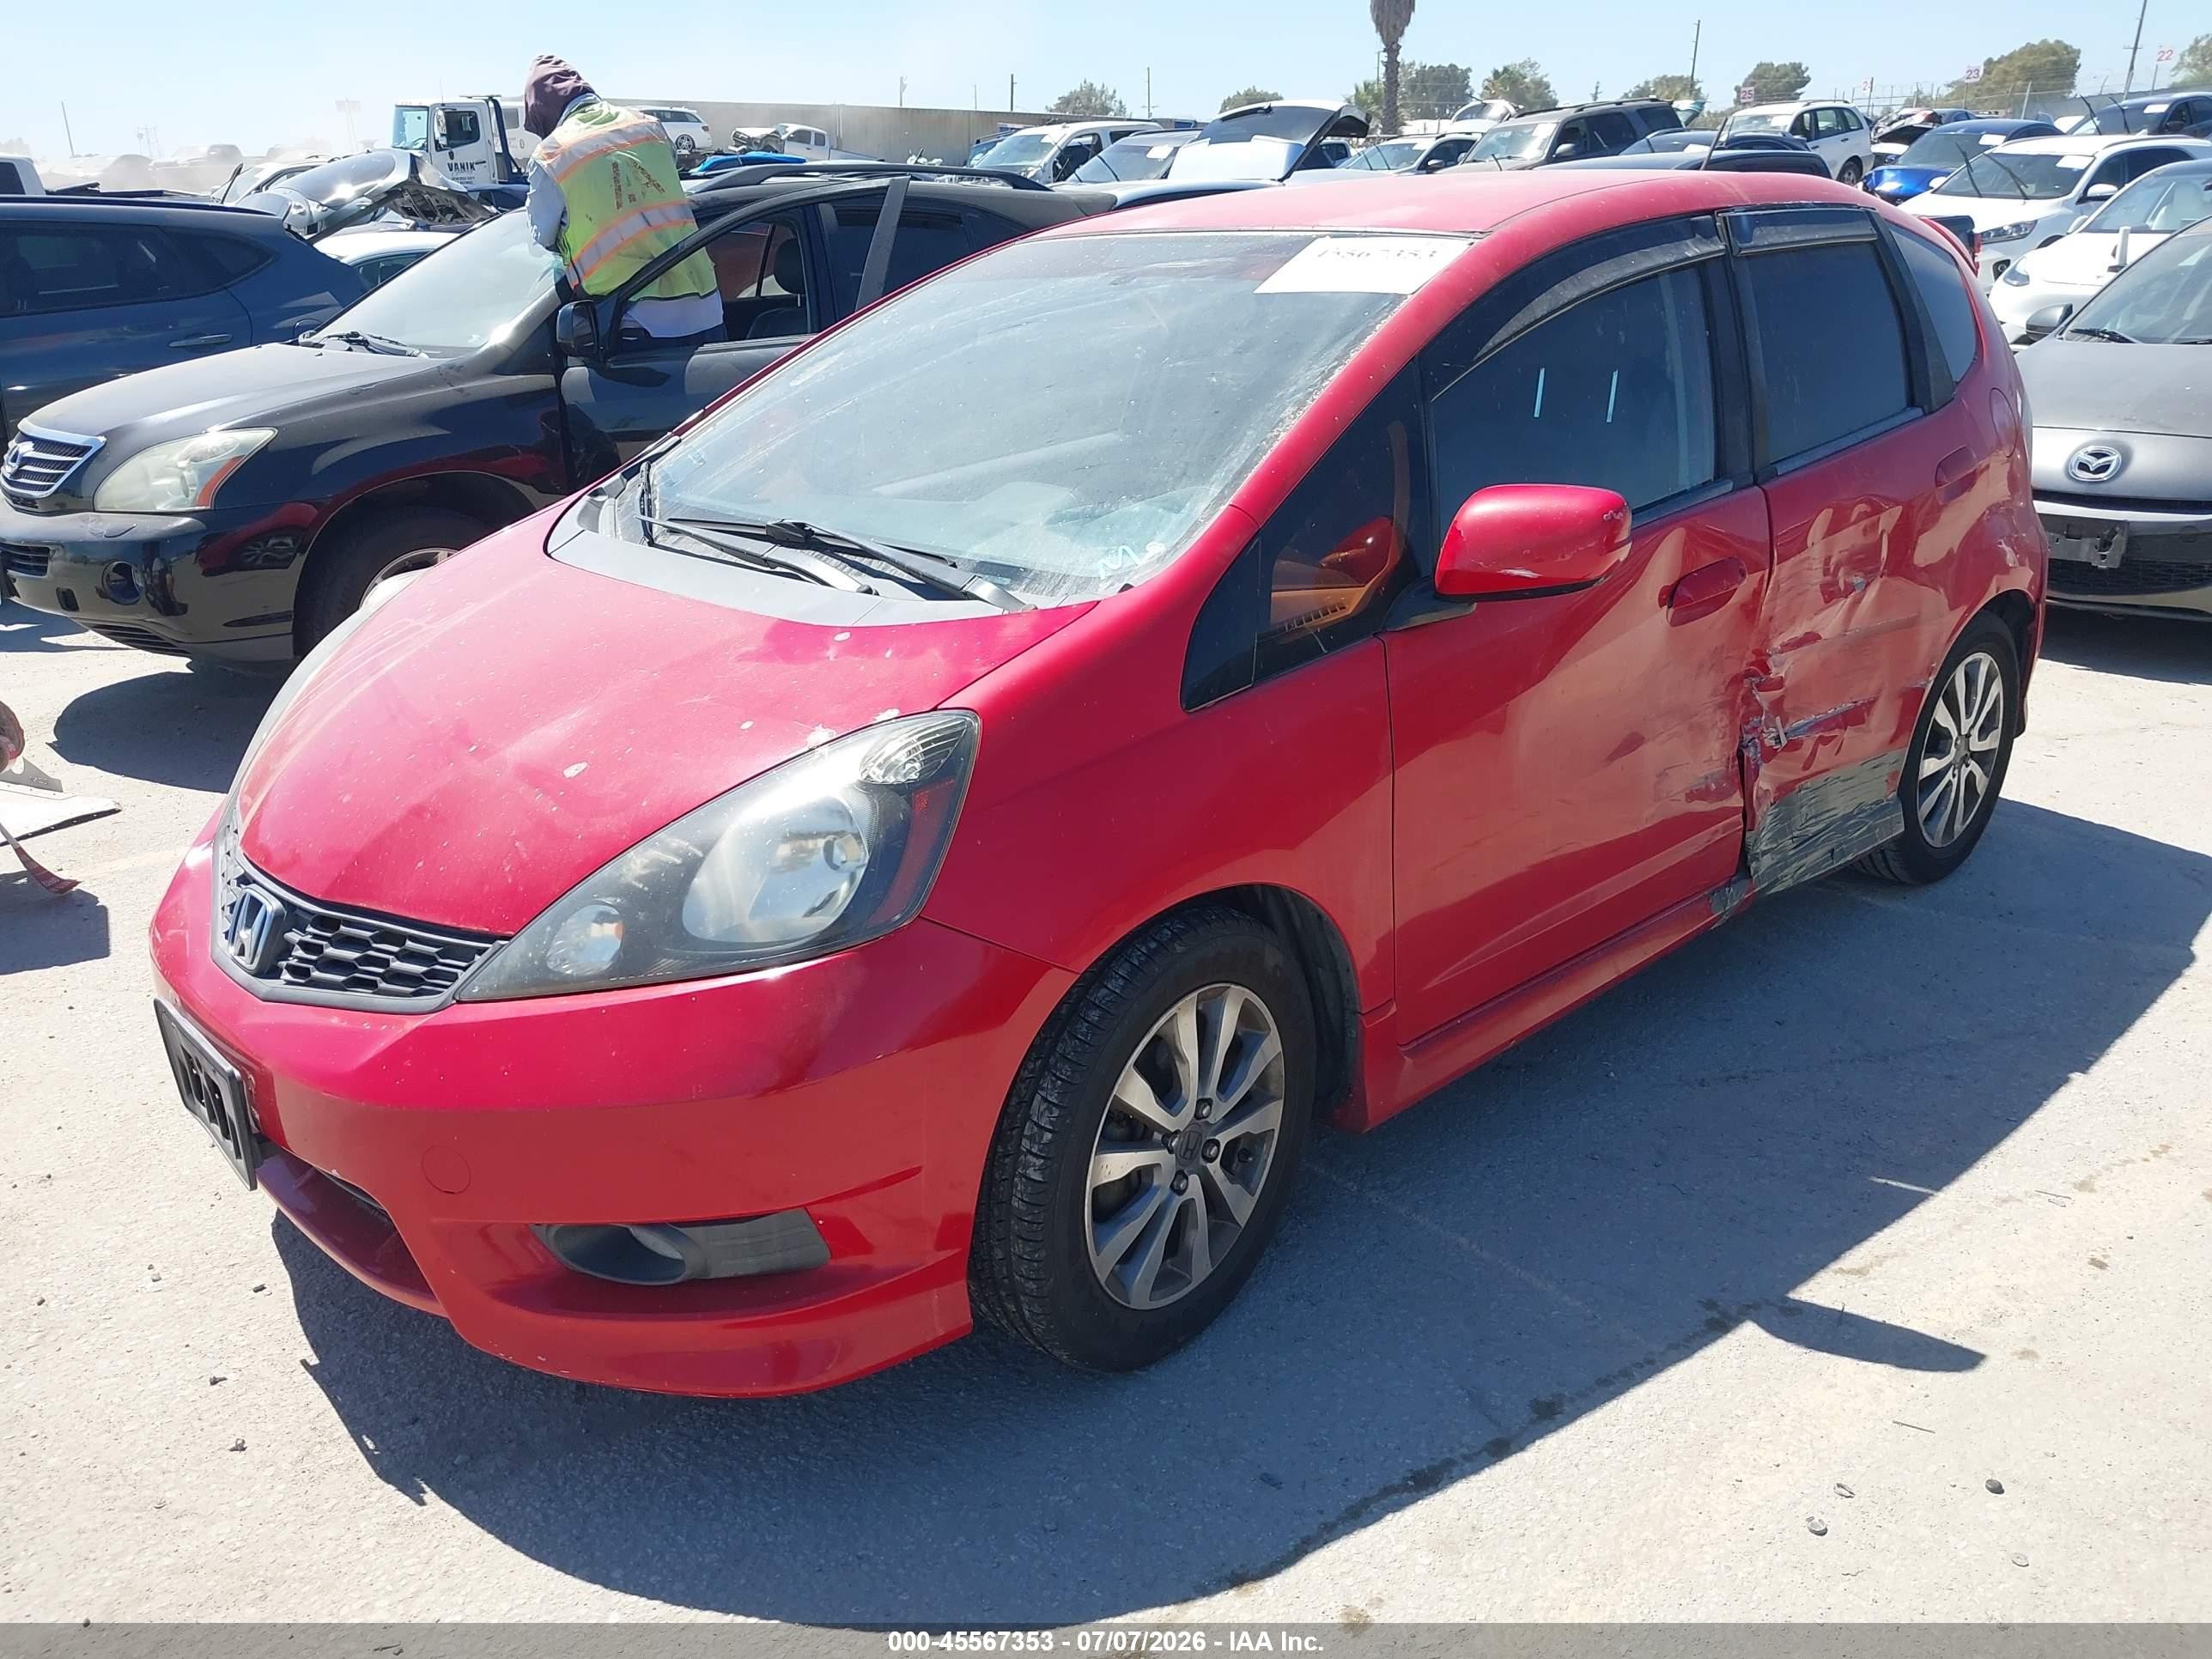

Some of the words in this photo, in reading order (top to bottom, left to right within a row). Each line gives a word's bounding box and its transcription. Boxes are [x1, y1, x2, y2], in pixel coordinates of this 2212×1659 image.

[2156, 49, 2173, 62] 22
[1966, 68, 1980, 80] 23
[1741, 89, 1753, 100] 25
[447, 161, 476, 172] VANIK
